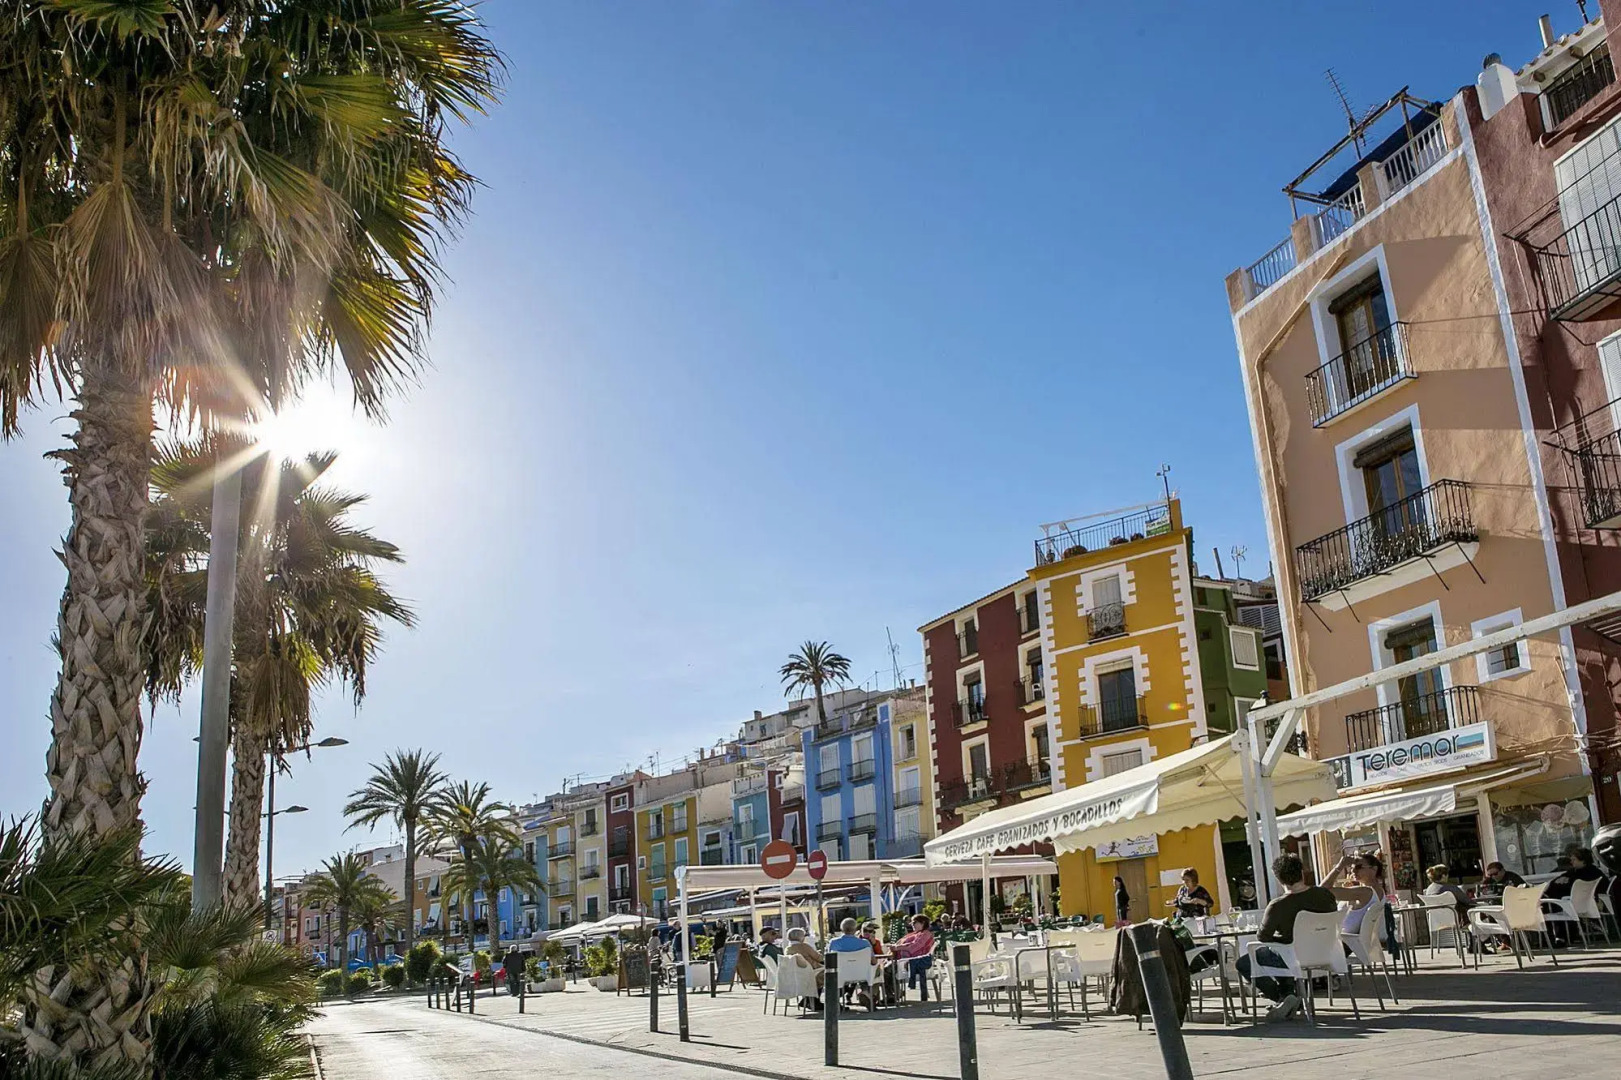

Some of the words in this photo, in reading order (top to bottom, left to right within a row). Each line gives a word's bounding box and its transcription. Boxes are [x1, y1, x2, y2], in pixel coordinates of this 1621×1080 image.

[1356, 733, 1460, 781] Teremar
[997, 819, 1050, 846] GRANIZADOS
[1053, 816, 1059, 831] Y
[1062, 798, 1123, 829] BOCADILLOS
